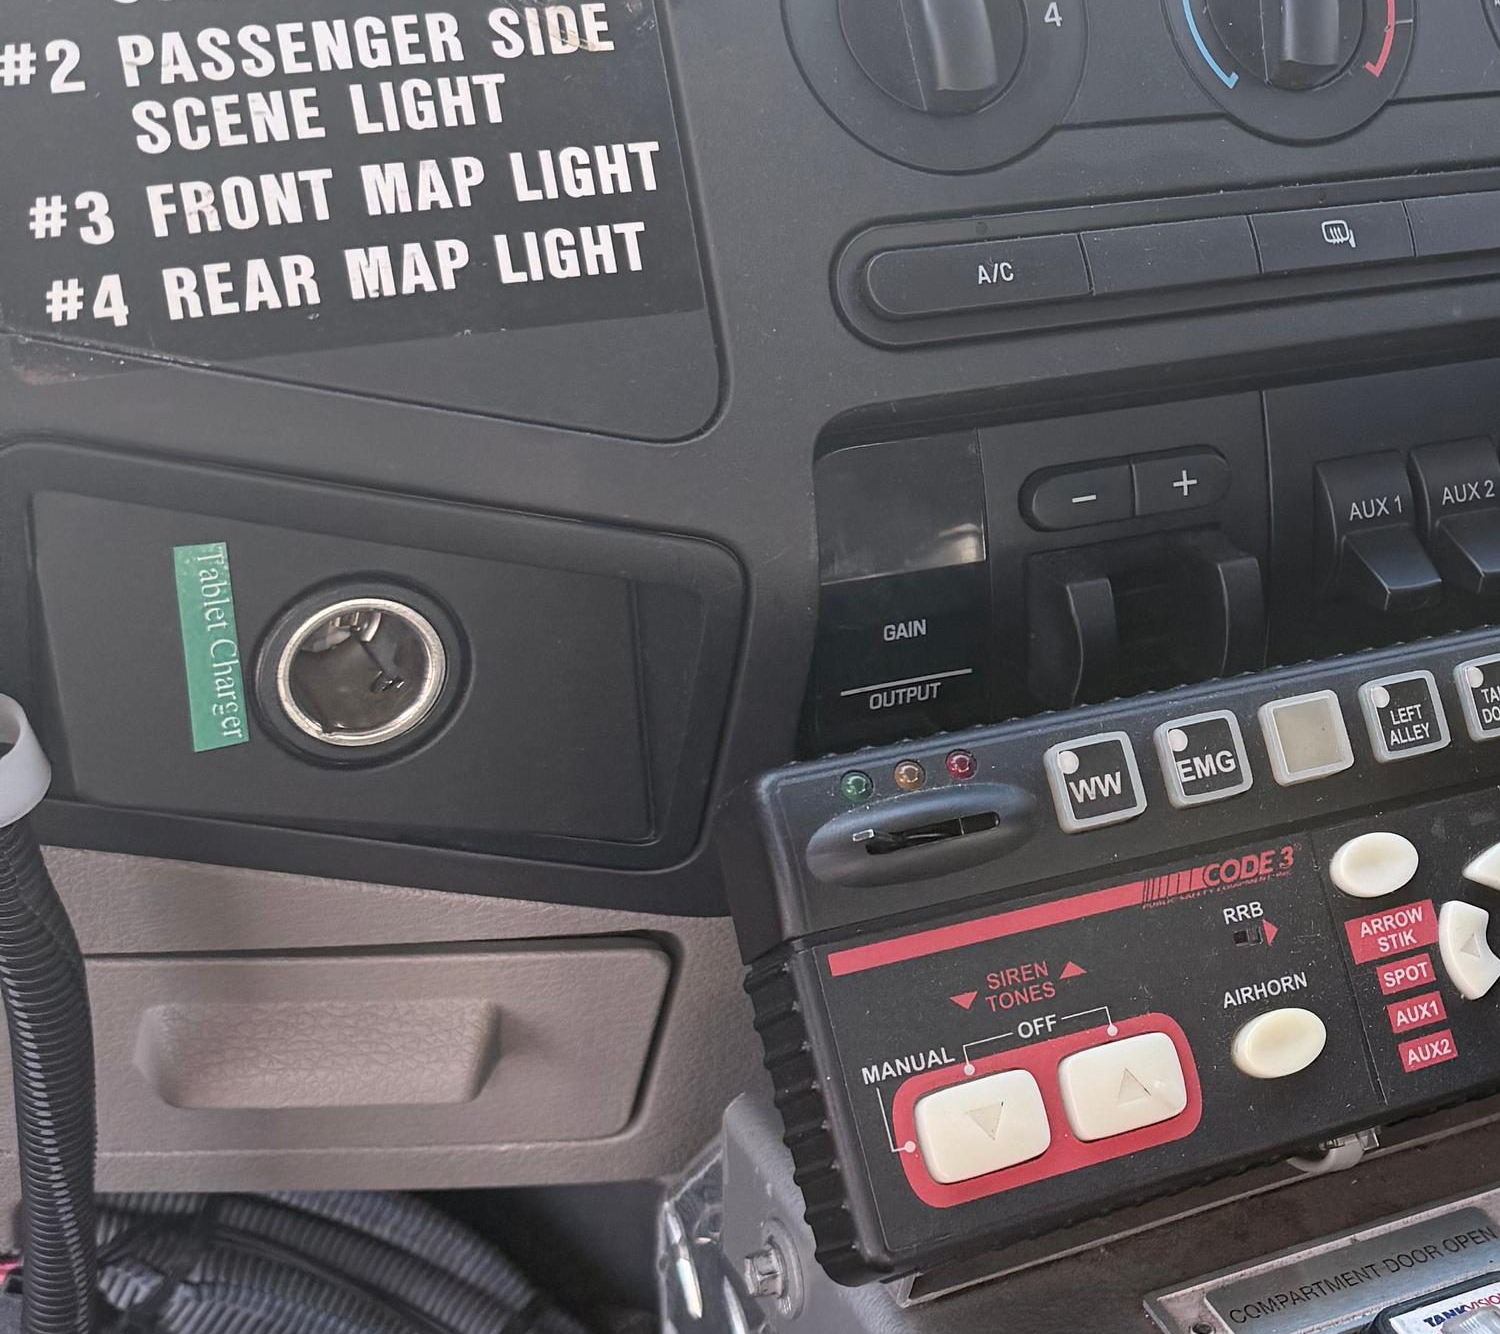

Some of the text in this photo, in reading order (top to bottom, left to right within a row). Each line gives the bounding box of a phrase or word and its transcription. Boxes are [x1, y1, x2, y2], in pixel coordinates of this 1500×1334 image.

[1044, 1, 1063, 27] 4
[0, 3, 614, 93] #2 PASSENGER SIDE
[132, 74, 505, 154] SCENE LIGHT
[29, 142, 659, 245] #3 FRONT MAP LIGHT
[45, 223, 645, 327] #4 REAR MAP LIGHT
[977, 261, 1014, 285] A/C
[1441, 479, 1495, 505] AUX 2
[1349, 495, 1403, 521] AUX 1
[196, 544, 244, 740] Tablet Charger
[883, 618, 927, 642] GAIN
[869, 682, 941, 710] OUTPUT
[1389, 703, 1423, 726] LEFT
[1389, 722, 1431, 746] ALLEY
[1177, 749, 1236, 783] EMG
[1069, 771, 1123, 803] WW
[1203, 846, 1294, 886] CODE 3
[1223, 901, 1264, 925] RRB
[1359, 907, 1423, 938] ARROW
[1377, 929, 1417, 952] STIK
[986, 960, 1049, 990] SIREN
[1383, 962, 1428, 987] SPOT
[985, 983, 1056, 1013] TONES
[1223, 972, 1308, 1009] AIRHORN
[1017, 1014, 1057, 1040] OFF
[1395, 1000, 1440, 1027] AUX1
[861, 1047, 956, 1085] MANUAL
[1407, 1039, 1451, 1066] AUX2
[1229, 1226, 1498, 1324] COMPARTMENT DOOR OPEN
